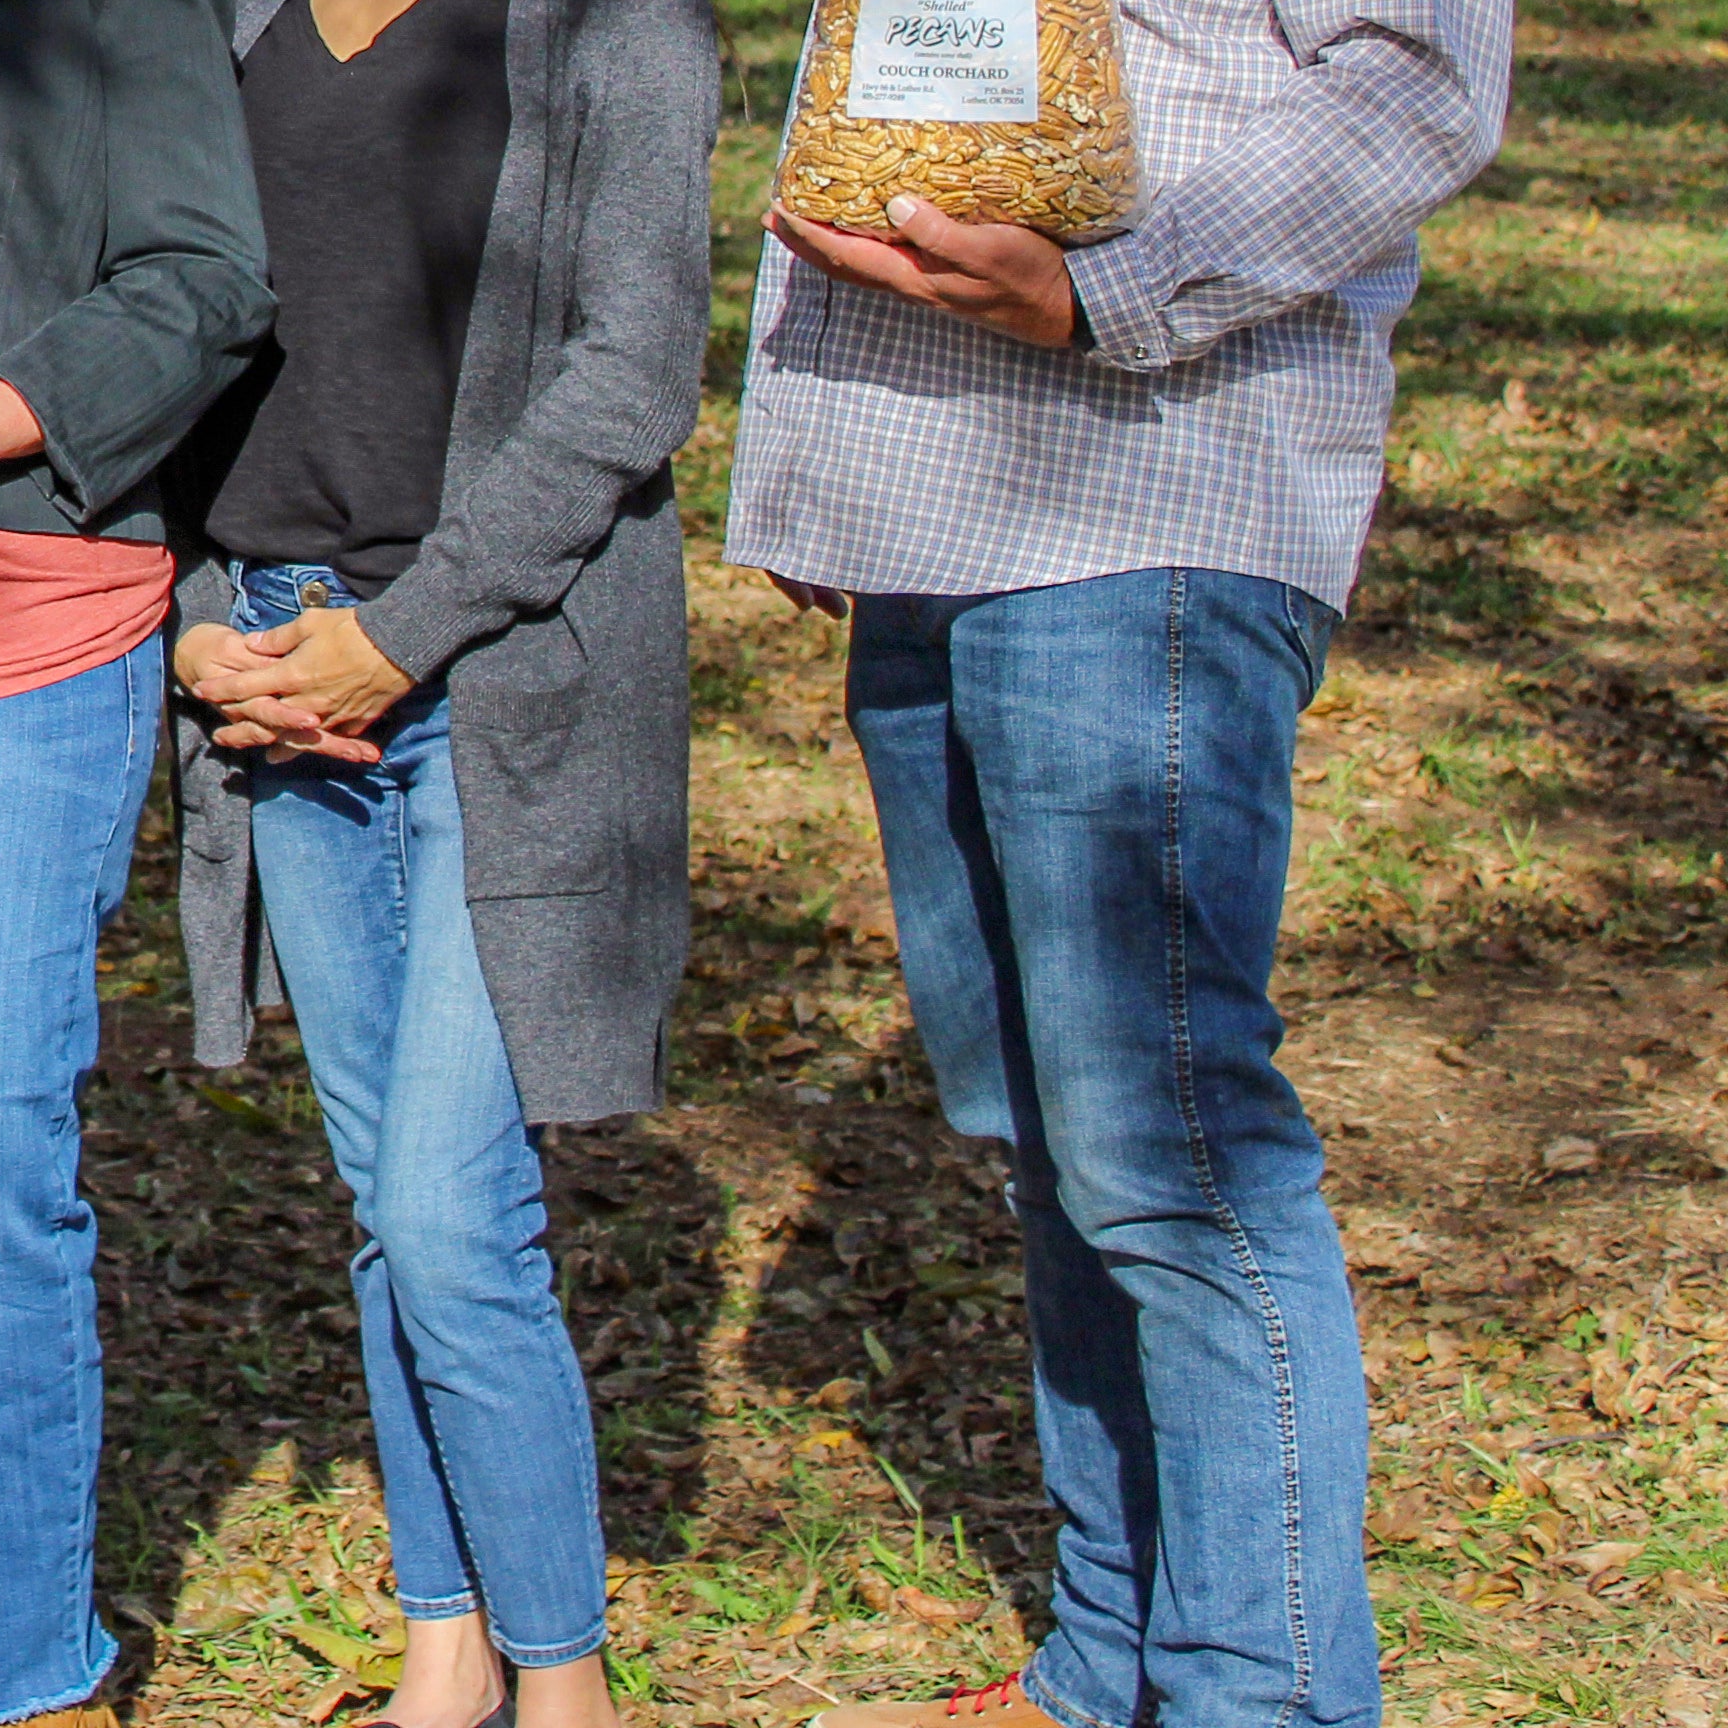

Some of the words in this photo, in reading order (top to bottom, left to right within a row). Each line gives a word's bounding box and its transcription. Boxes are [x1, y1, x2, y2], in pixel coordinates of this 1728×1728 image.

[918, 0, 975, 12] "Shelled"
[884, 15, 1005, 49] PECANS
[879, 64, 929, 78] COUCH
[932, 66, 1009, 80] ORCHARD
